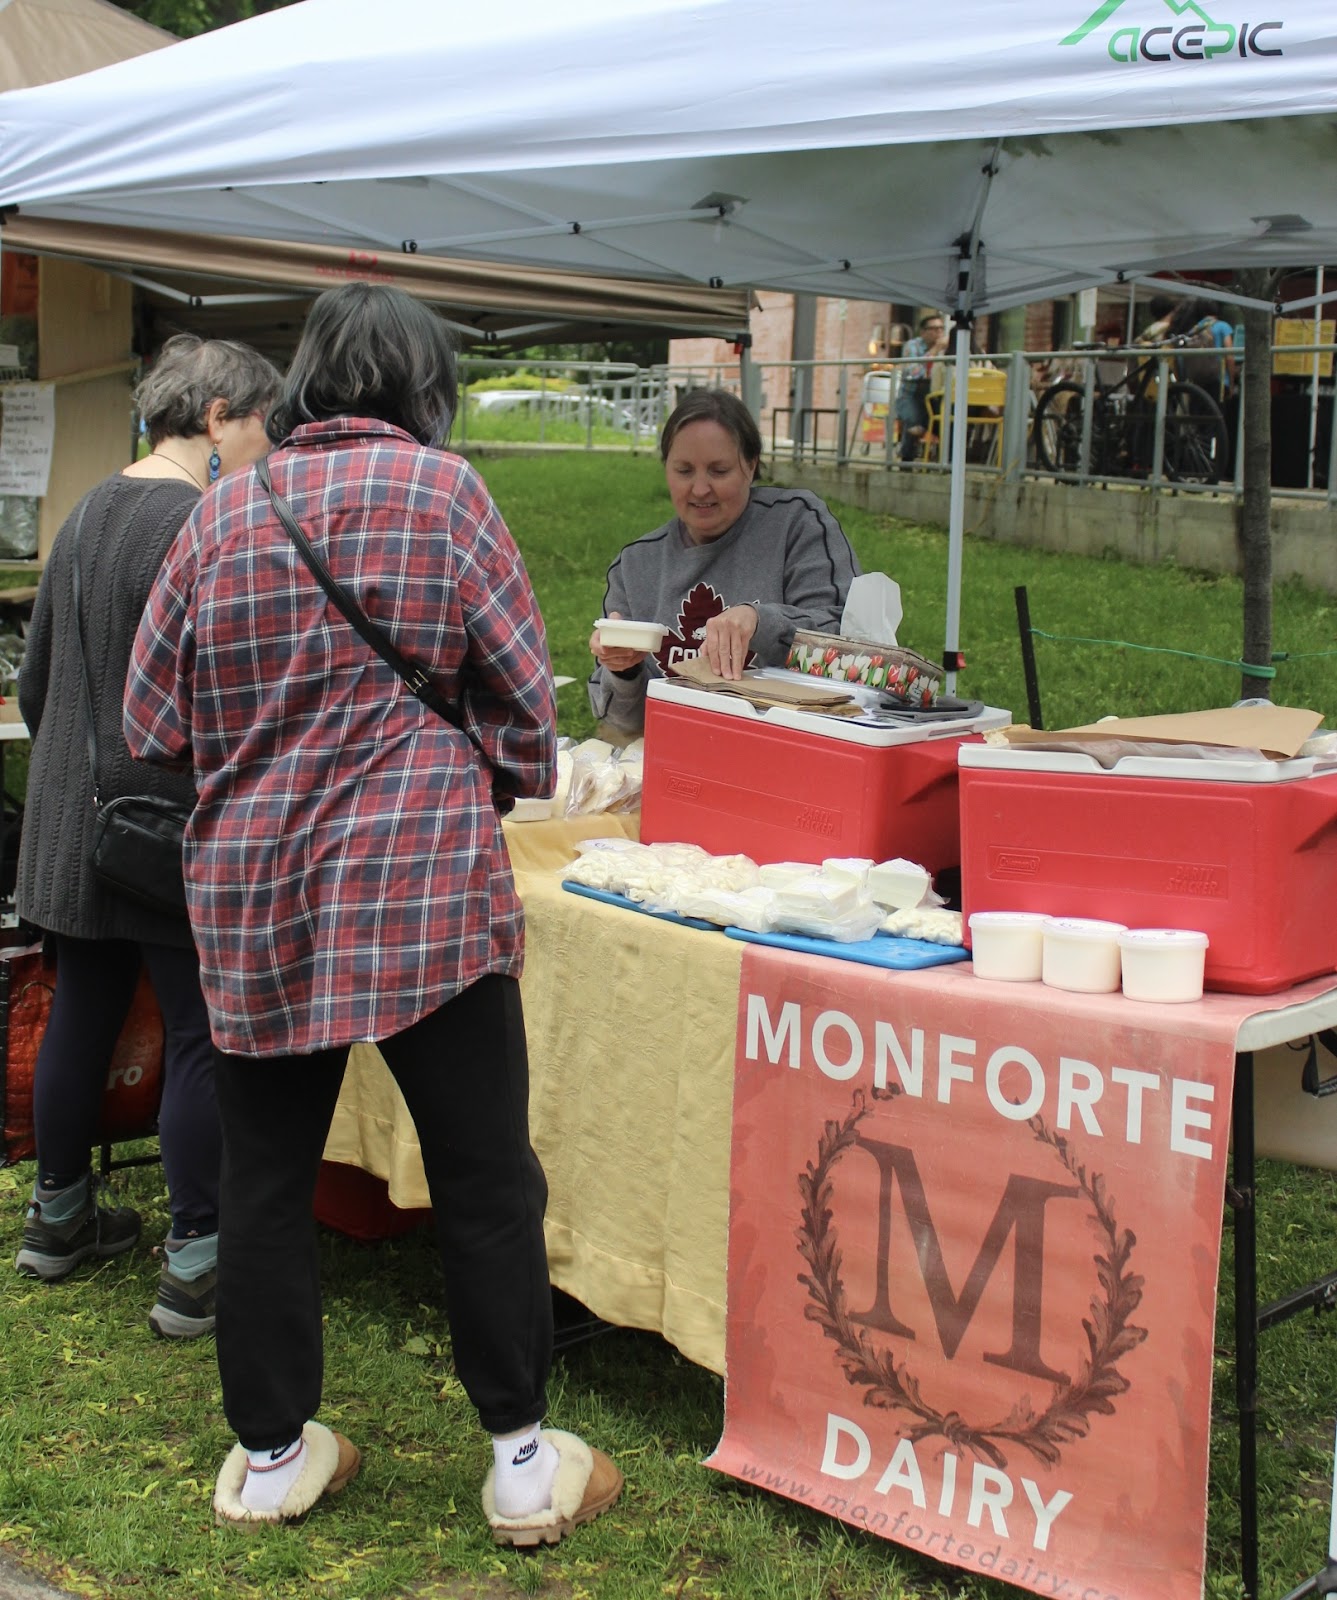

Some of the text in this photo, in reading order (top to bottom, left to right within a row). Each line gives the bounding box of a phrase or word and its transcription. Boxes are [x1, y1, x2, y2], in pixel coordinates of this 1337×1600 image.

[794, 815, 833, 836] STACKER
[802, 806, 831, 824] PARTY
[745, 993, 1215, 1161] MONFORTE
[848, 1137, 1081, 1386] M
[820, 1413, 1074, 1552] DAIRY
